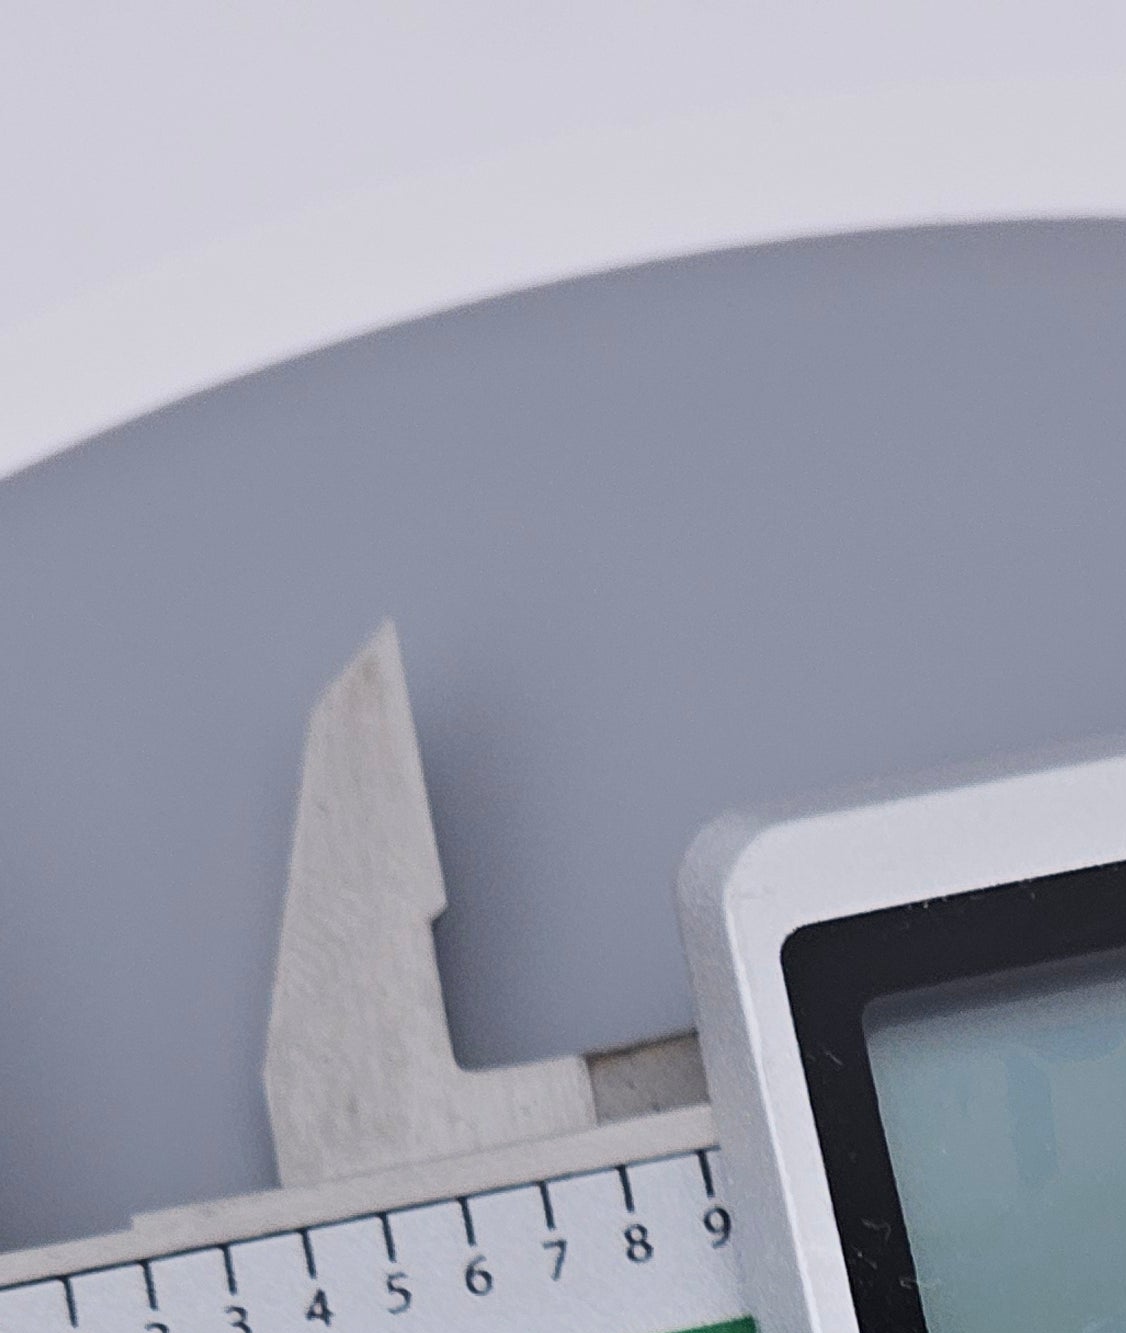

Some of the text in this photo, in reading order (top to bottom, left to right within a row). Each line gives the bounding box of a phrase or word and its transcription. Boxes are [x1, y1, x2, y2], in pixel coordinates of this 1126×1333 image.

[304, 1288, 334, 1327] 4
[385, 1271, 413, 1316] 5
[464, 1255, 494, 1297] 6
[541, 1238, 568, 1282] 7
[623, 1223, 655, 1264] 8
[702, 1205, 733, 1249] 9
